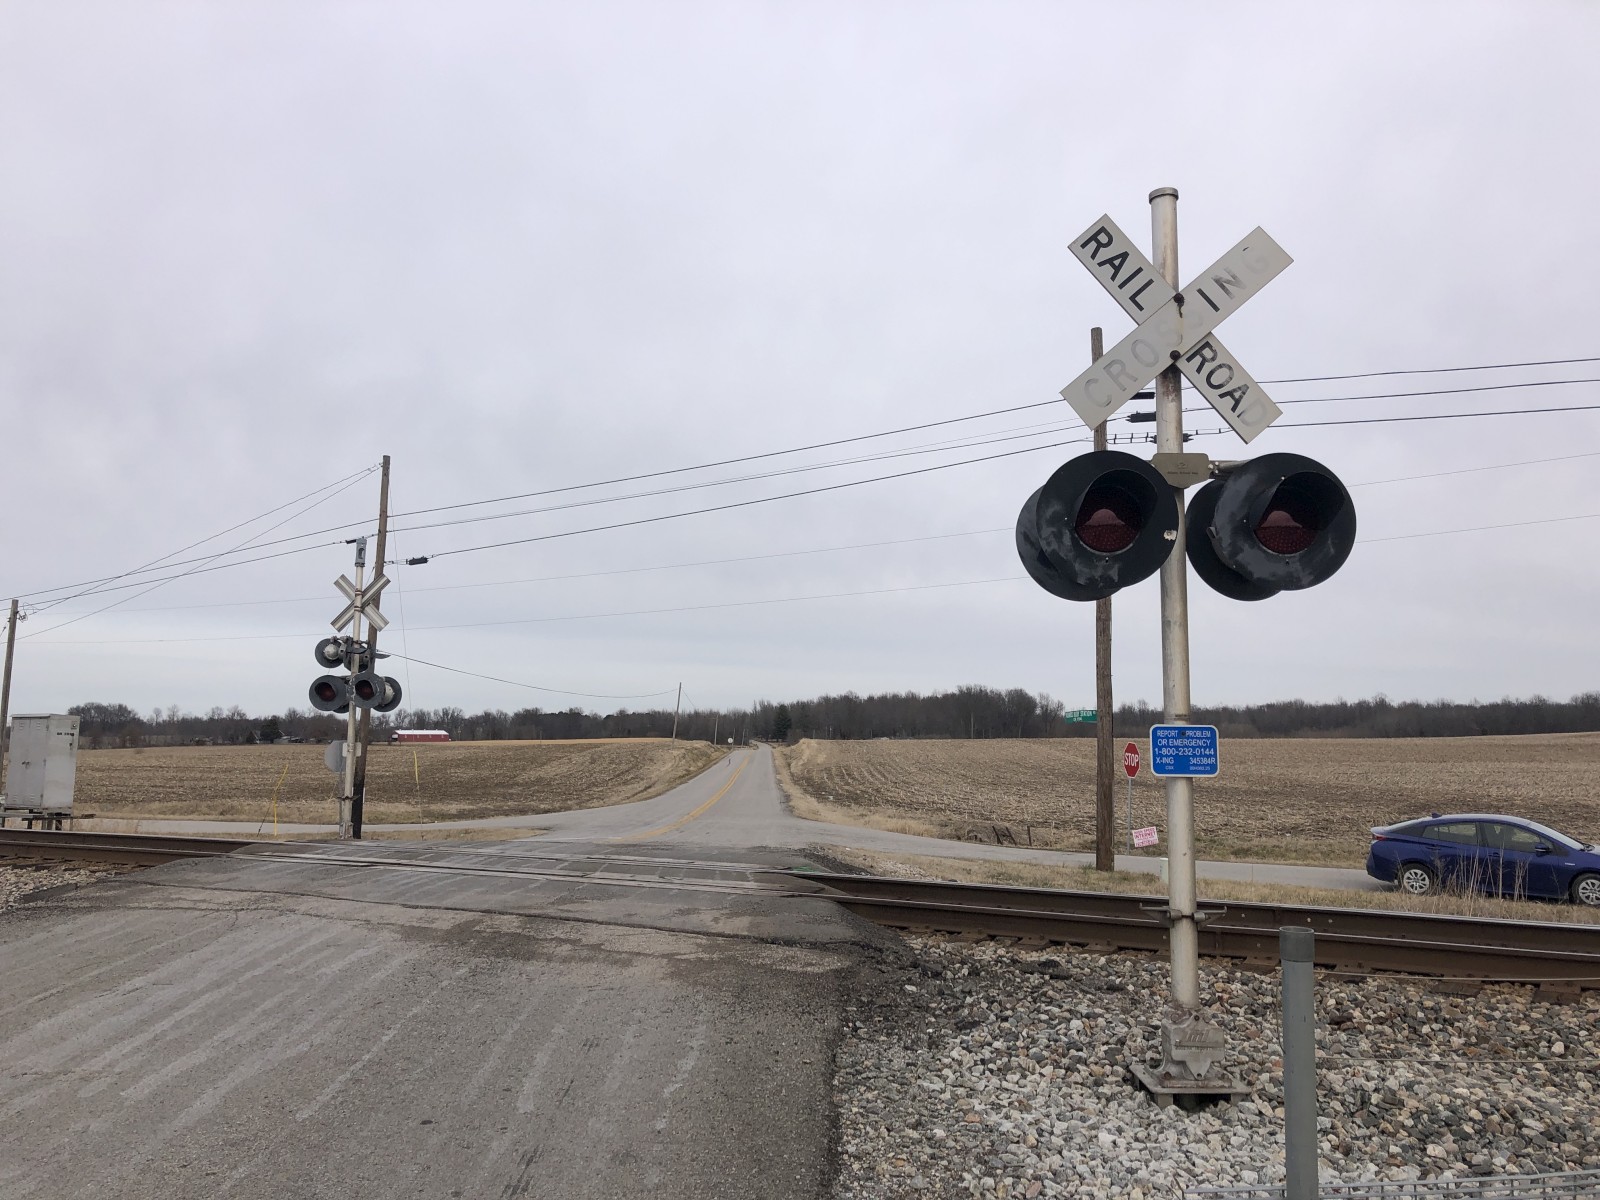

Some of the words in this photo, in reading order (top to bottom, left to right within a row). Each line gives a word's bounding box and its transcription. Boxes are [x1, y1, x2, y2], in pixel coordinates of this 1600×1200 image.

[1079, 225, 1155, 312] RAIL
[1184, 340, 1268, 428] ROAD
[1154, 748, 1214, 756] 1-800-232-0144
[1124, 753, 1139, 767] STOP
[1189, 757, 1216, 765] 345384R
[1134, 831, 1156, 839] INTERNET
